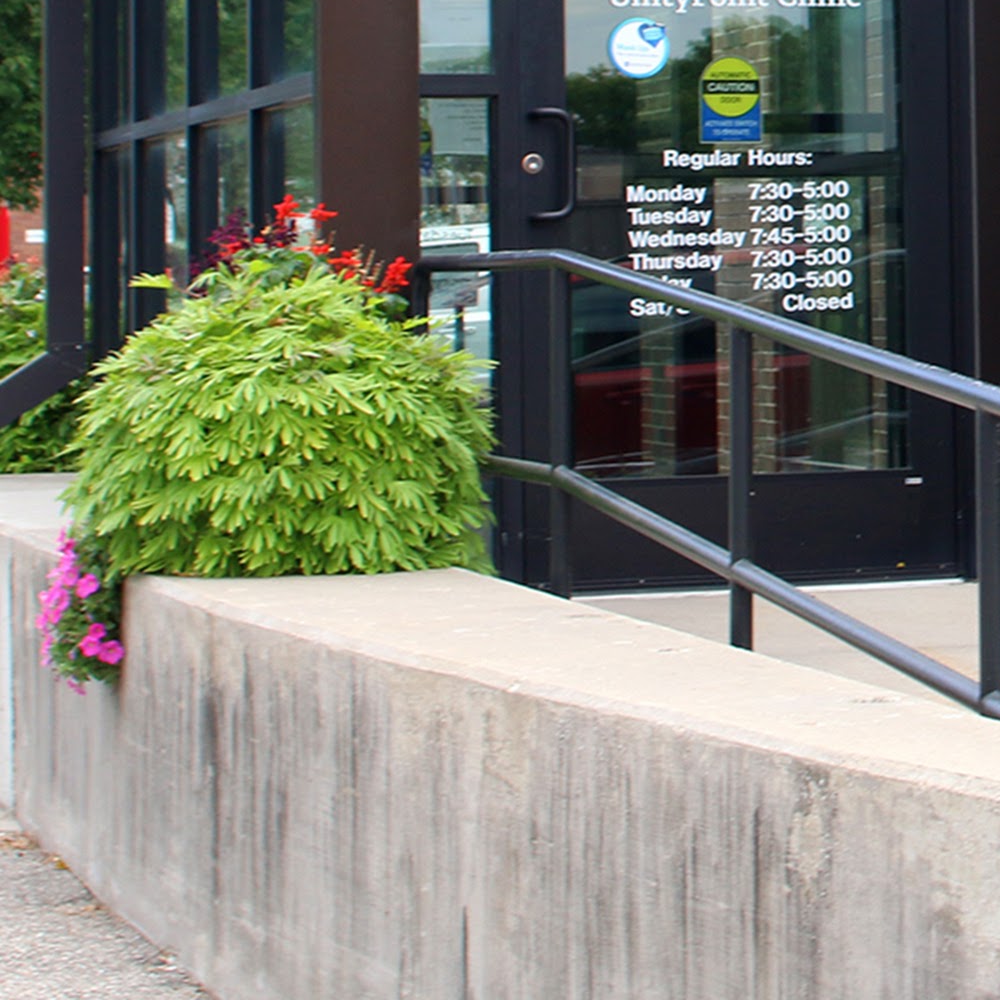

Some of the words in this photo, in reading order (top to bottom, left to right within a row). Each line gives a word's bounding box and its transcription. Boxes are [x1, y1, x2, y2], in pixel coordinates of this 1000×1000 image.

[707, 82, 755, 92] CAUTION
[663, 150, 741, 170] Regular
[748, 150, 813, 166] Hours:
[626, 184, 707, 203] Monday
[627, 206, 712, 226] Tuesday
[628, 229, 746, 248] Wednesday
[628, 251, 722, 271] Thursday
[782, 293, 854, 312] Closed
